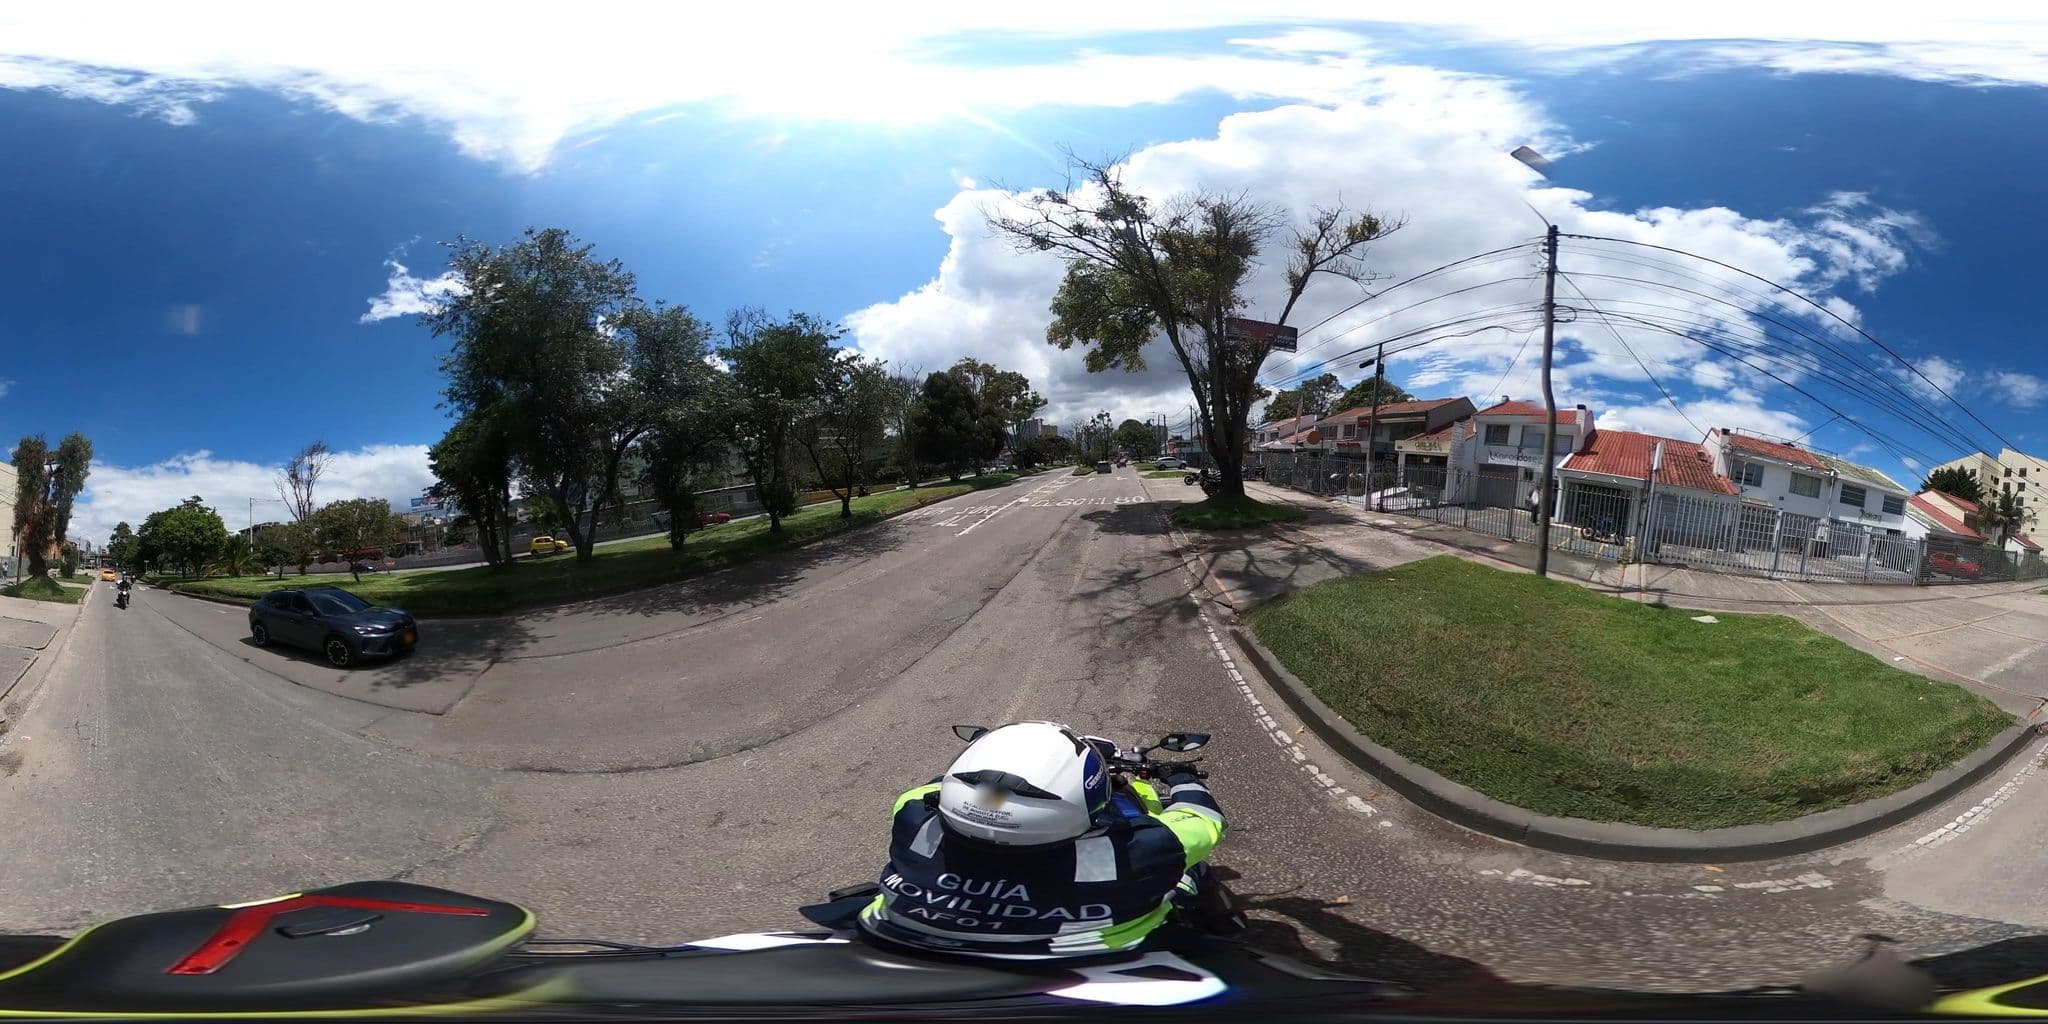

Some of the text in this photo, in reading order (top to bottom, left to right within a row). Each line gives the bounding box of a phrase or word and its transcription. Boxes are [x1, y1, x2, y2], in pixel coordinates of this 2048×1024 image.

[1114, 495, 1145, 504] 80
[883, 873, 1113, 920] MOVILIDAD
[936, 872, 1031, 902] GUÍA
[907, 906, 1004, 930] AF01
